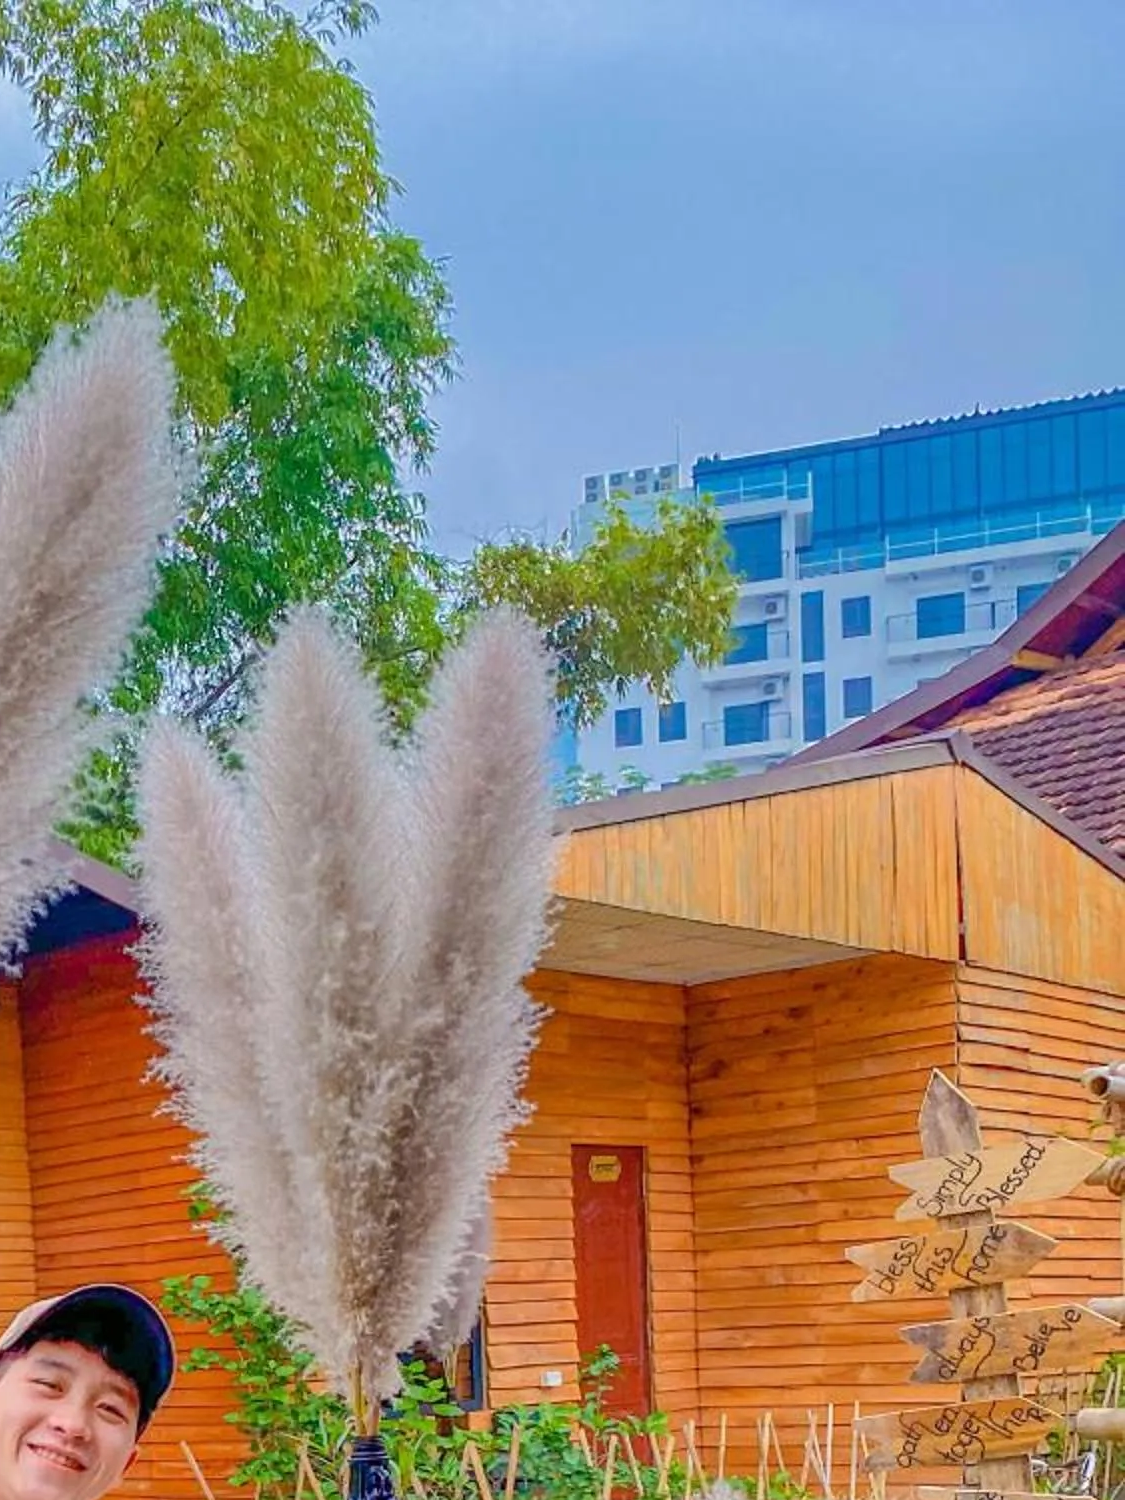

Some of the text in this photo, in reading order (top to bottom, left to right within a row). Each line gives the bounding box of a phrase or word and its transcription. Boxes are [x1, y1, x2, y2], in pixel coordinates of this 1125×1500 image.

[867, 1223, 1008, 1295] bless this home
